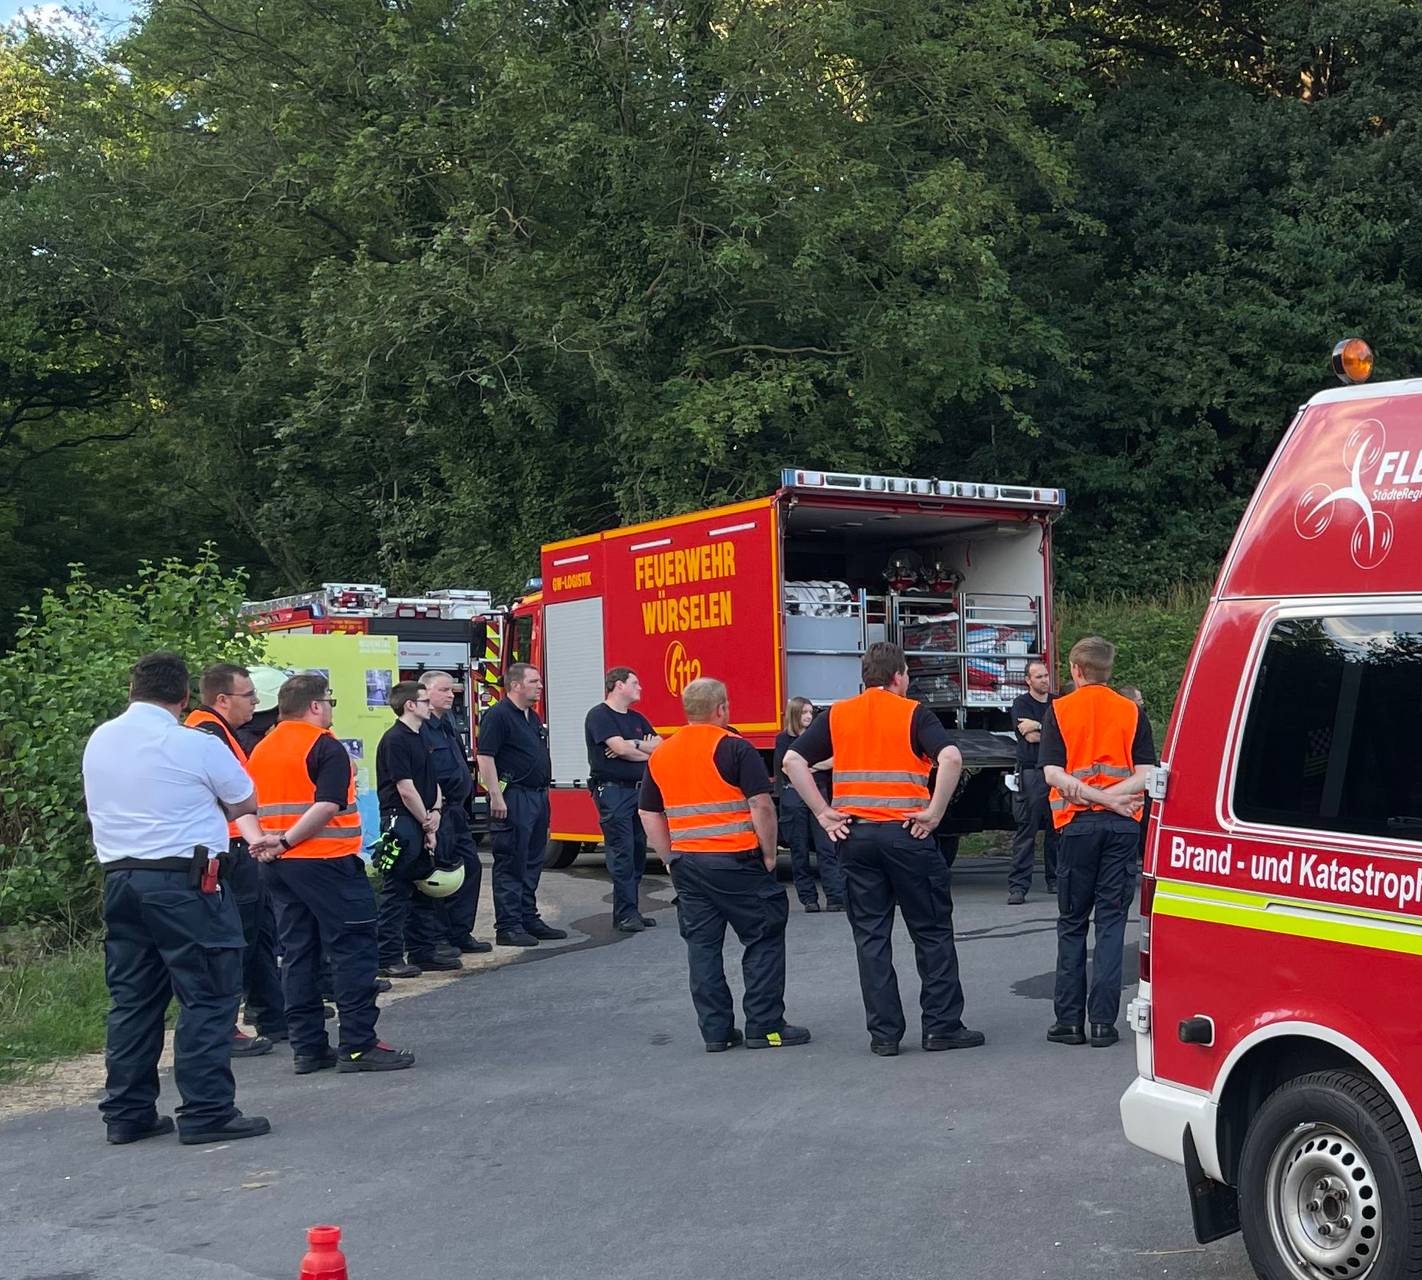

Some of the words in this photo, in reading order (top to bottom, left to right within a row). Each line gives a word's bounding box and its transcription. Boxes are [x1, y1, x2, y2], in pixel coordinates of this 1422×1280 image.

[552, 571, 592, 592] GW-LOGISTIK
[634, 541, 736, 591] FEUERWEHR
[641, 590, 732, 635] WÜRSELEN
[1170, 836, 1231, 875] Brand
[1251, 852, 1293, 884] und
